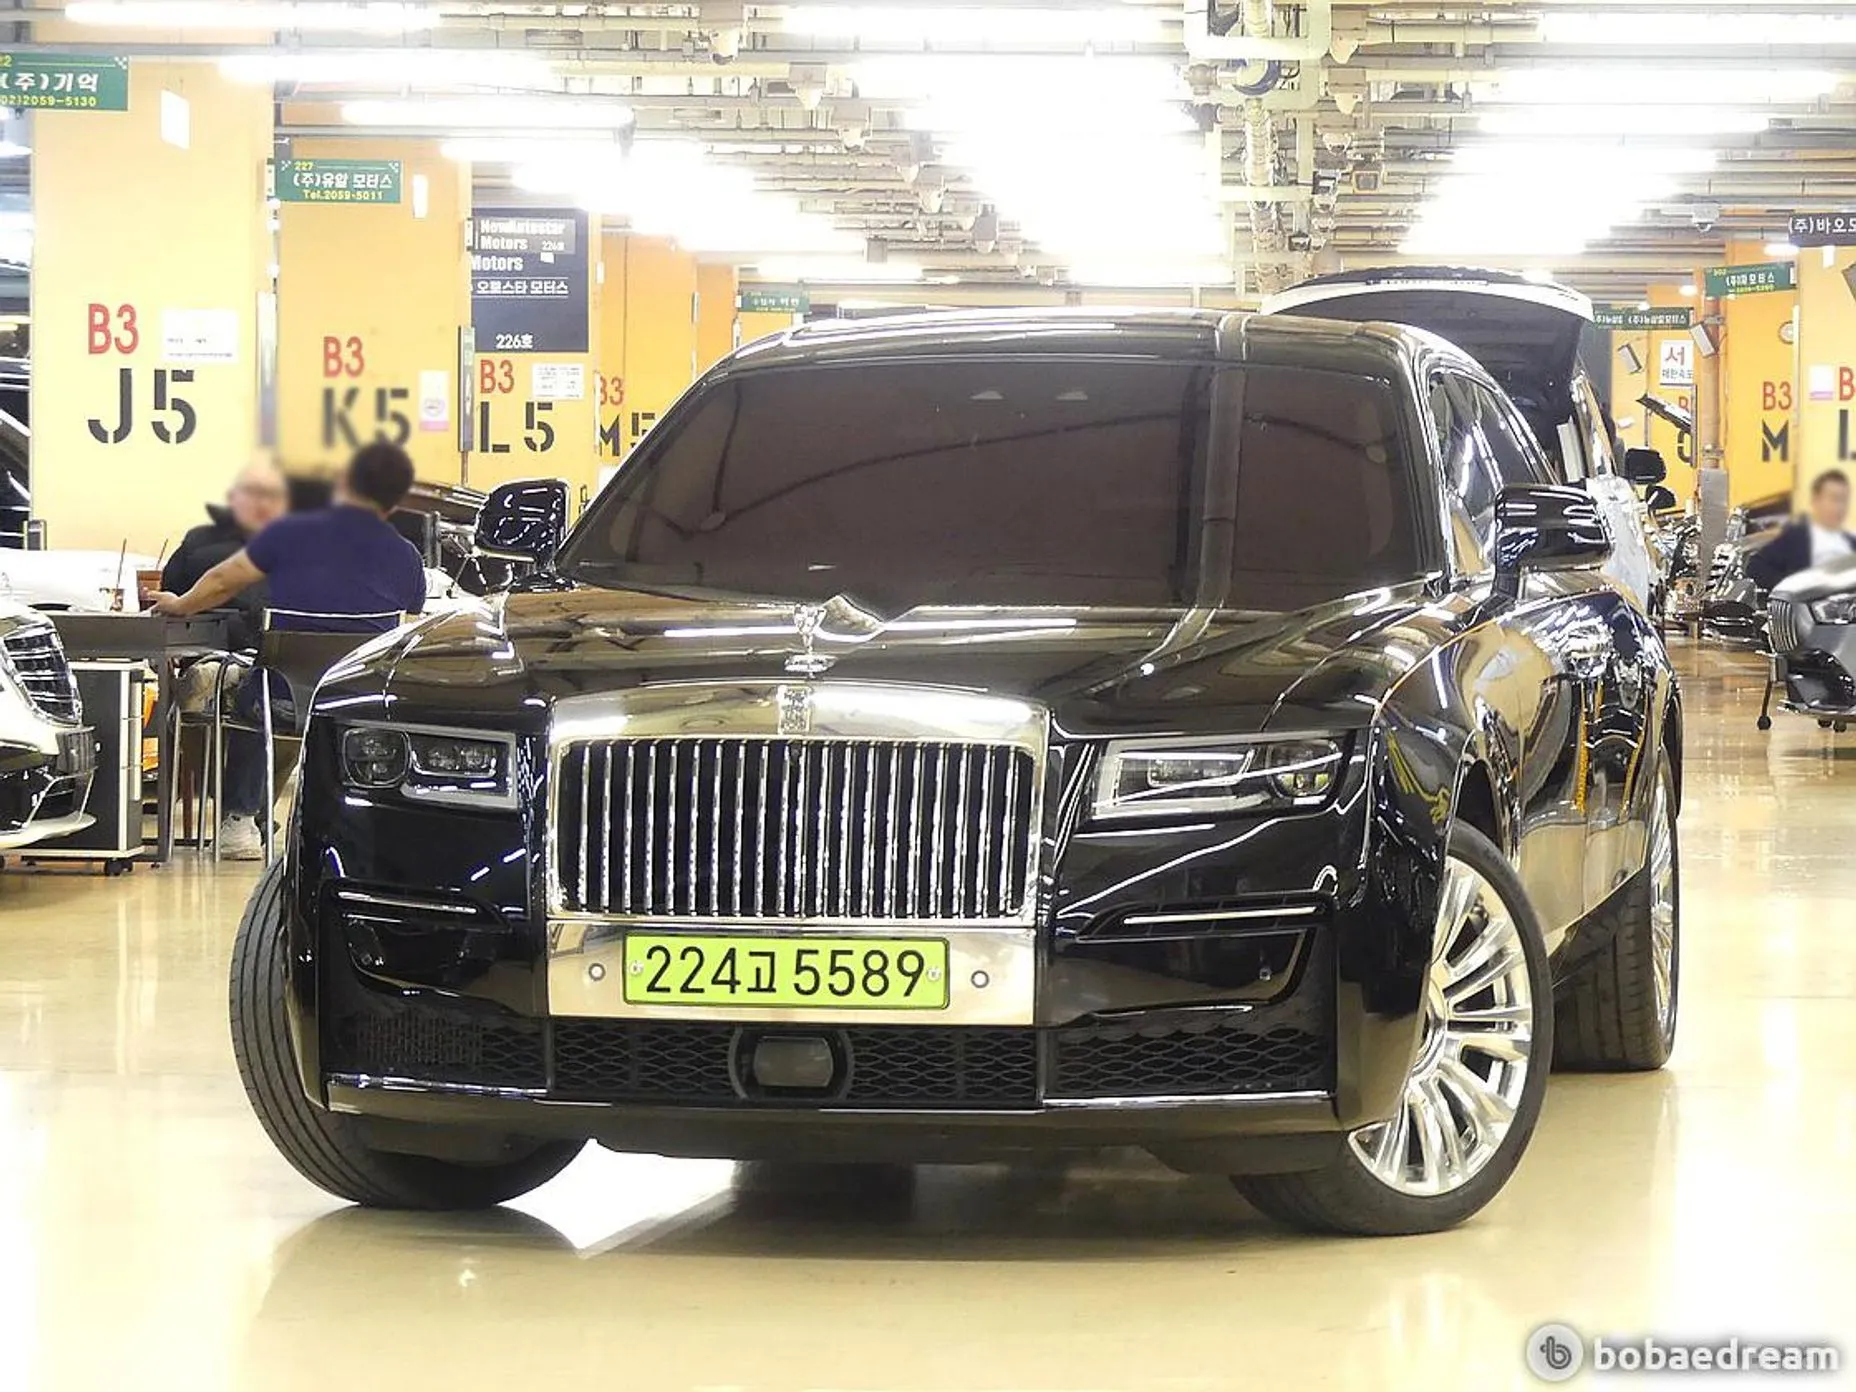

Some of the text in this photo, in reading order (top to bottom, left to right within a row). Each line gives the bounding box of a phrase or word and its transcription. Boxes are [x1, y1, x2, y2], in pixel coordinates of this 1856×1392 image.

[3, 72, 99, 92] (주)기억
[294, 161, 314, 171] 227
[353, 173, 392, 189] 모터스
[480, 236, 528, 250] Motors
[530, 281, 569, 295] 모터스
[88, 303, 139, 355] B3
[496, 333, 534, 349] 226호
[323, 336, 365, 378] B3
[1665, 346, 1686, 366] 서
[480, 359, 515, 394] B3
[1762, 381, 1792, 410] B3
[1762, 419, 1789, 462] M
[646, 945, 925, 998] 224고 5589
